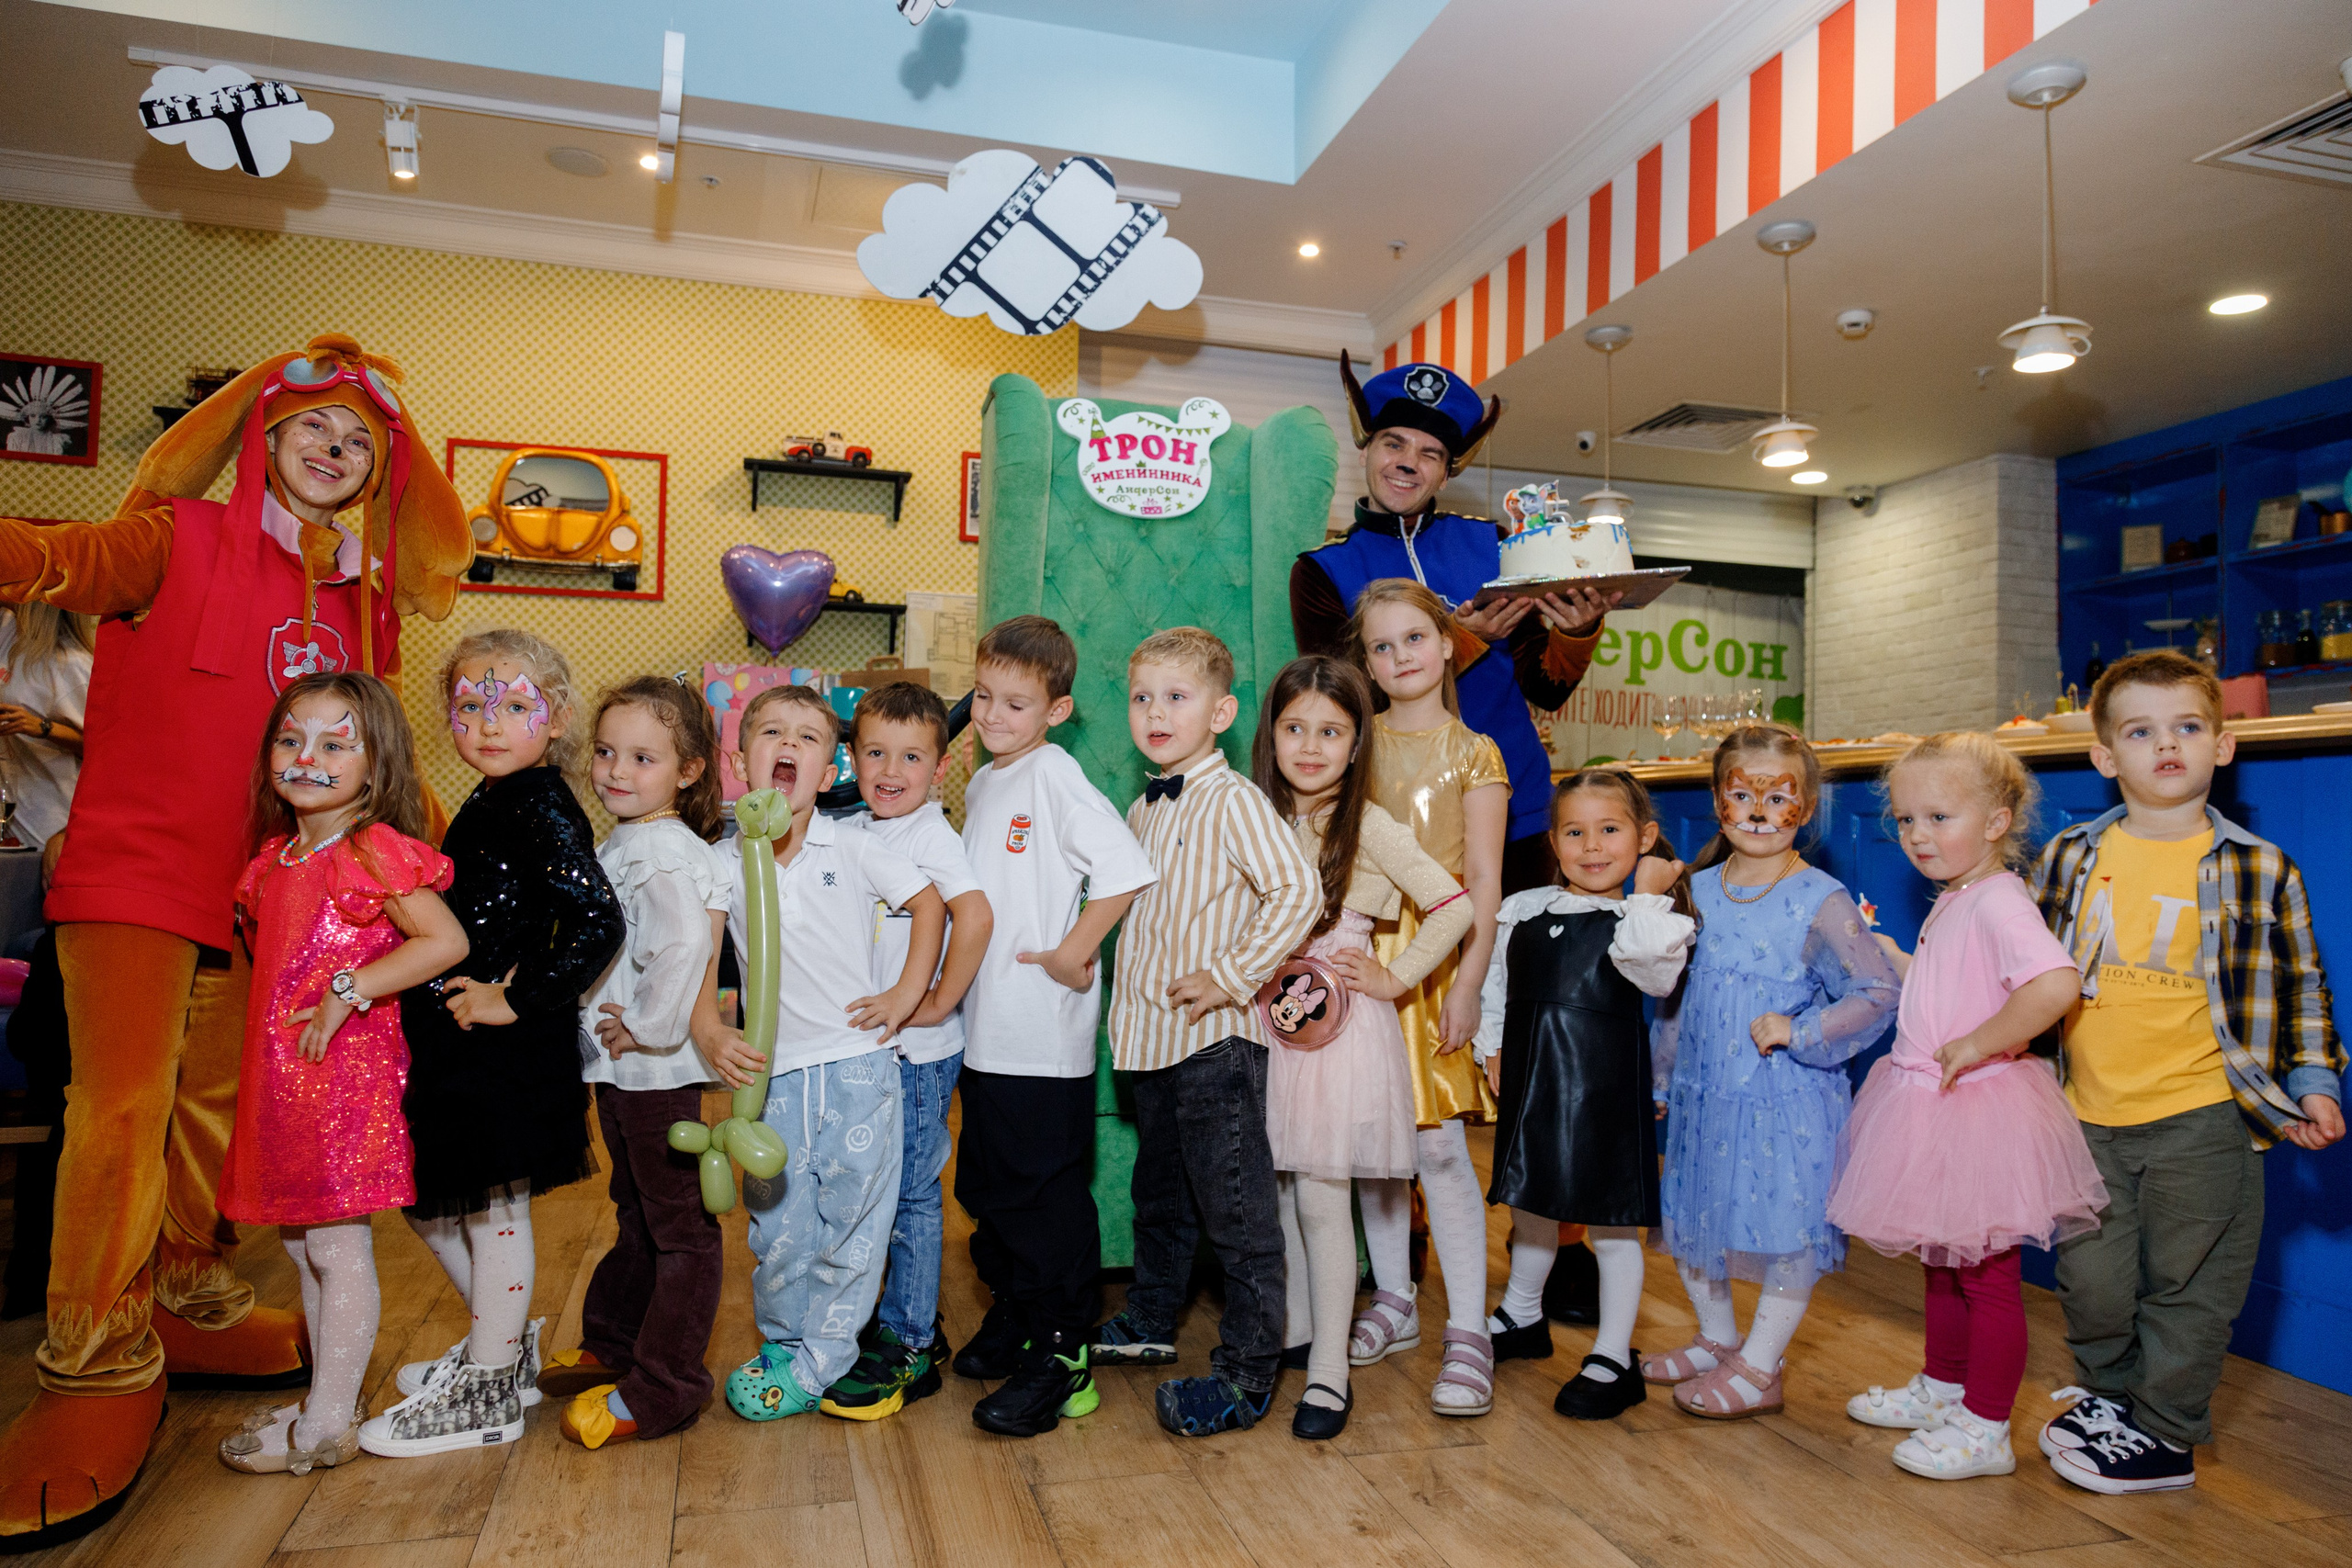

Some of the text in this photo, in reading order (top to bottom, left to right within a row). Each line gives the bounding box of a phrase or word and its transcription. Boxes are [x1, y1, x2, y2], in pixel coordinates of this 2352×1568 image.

[1089, 434, 1197, 465] ТРОН
[1091, 468, 1203, 488] ИМЕНИННИКА
[2146, 974, 2194, 989] CREW
